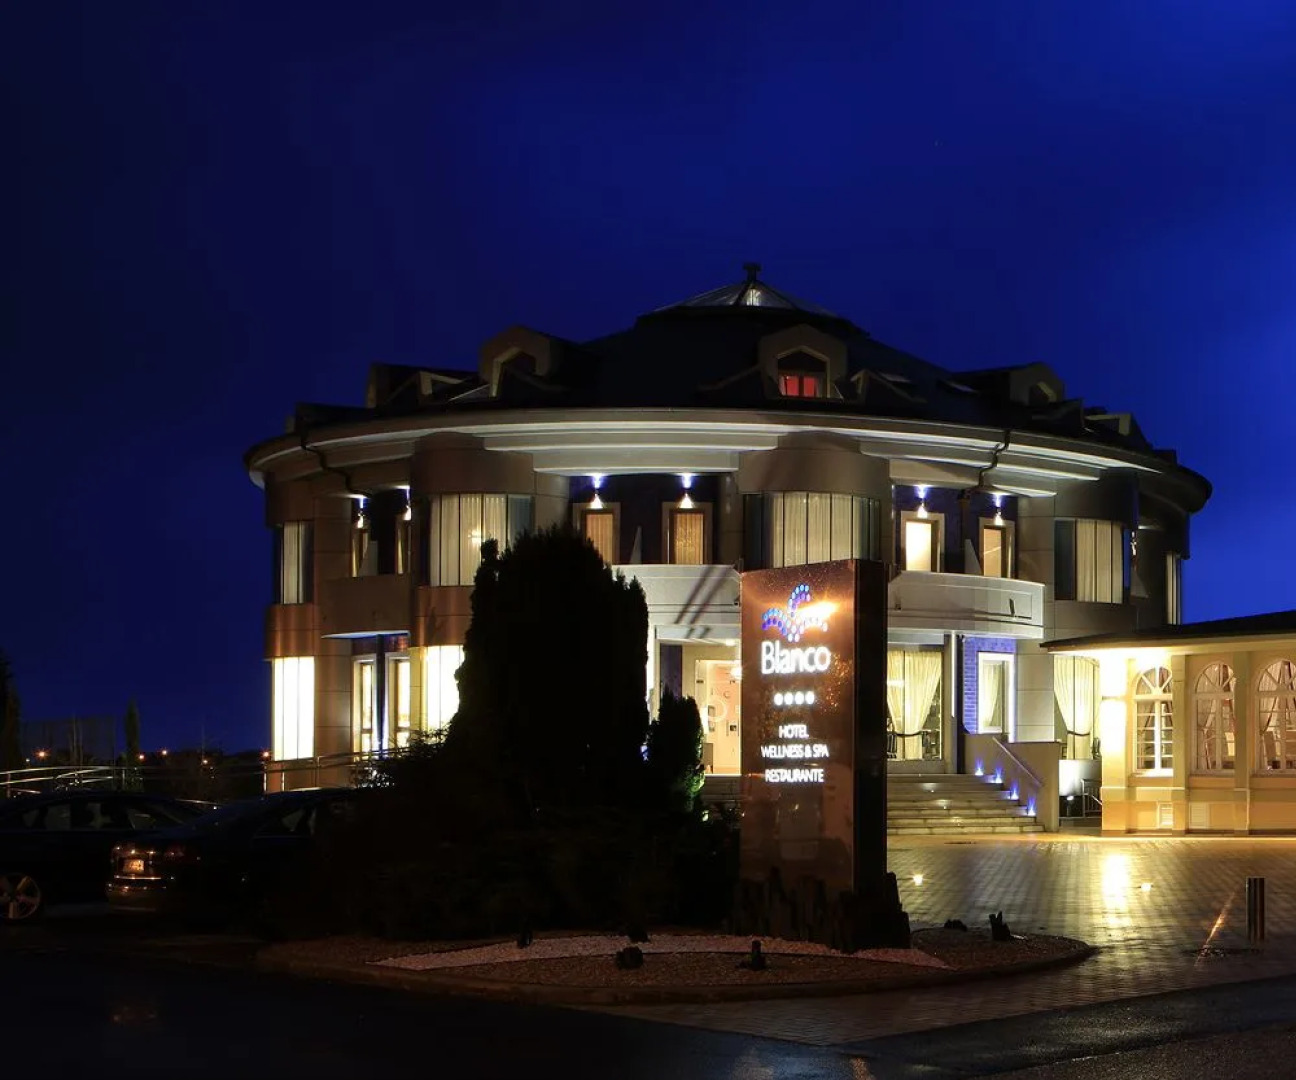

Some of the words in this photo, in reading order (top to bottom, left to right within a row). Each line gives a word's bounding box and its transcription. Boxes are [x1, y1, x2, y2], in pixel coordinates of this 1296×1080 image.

[761, 641, 831, 674] Blanco
[779, 724, 809, 738] HOTEL
[761, 744, 803, 758] WELLNESS
[805, 744, 812, 758] &
[813, 744, 829, 757] SPA
[765, 768, 824, 782] RESTAURANTE
